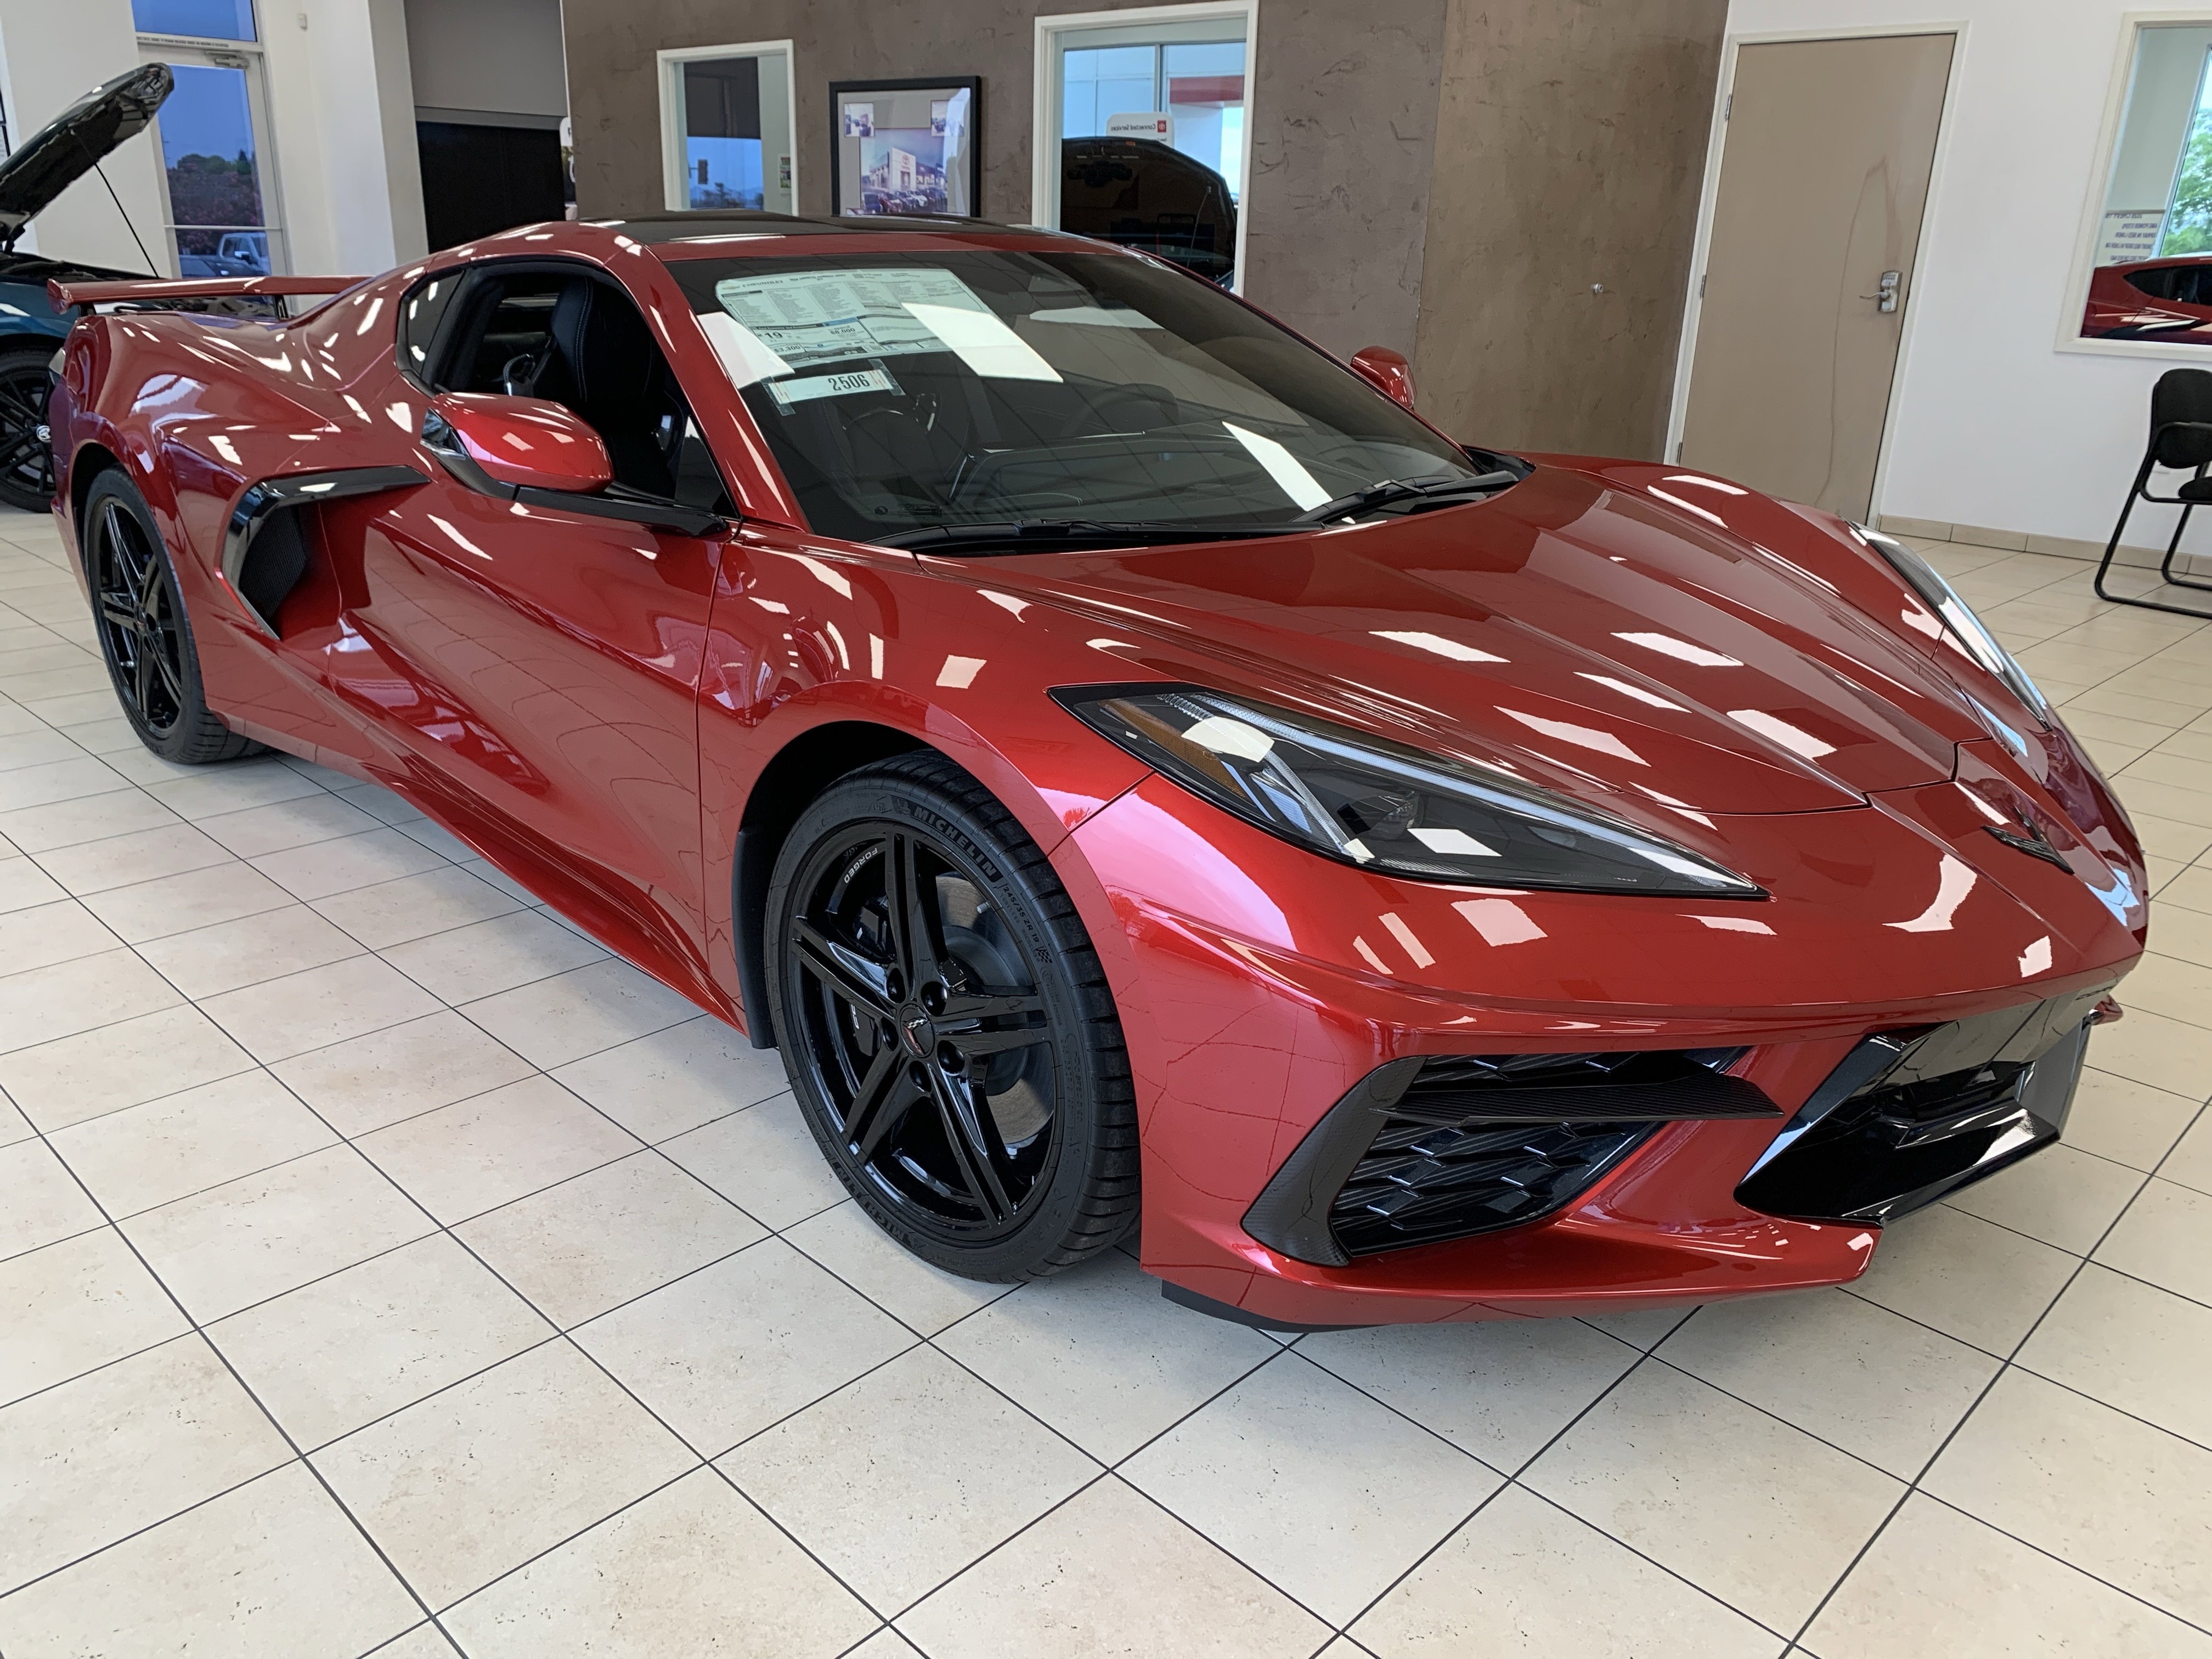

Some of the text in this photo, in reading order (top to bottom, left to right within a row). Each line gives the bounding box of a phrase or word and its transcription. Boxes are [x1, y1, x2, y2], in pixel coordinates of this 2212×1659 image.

[774, 345, 800, 353] $3,300
[827, 374, 871, 391] 2506
[913, 806, 997, 877] MICHELIN
[844, 847, 878, 884] FORGED
[1003, 887, 1040, 943] 245/35 ZR 19
